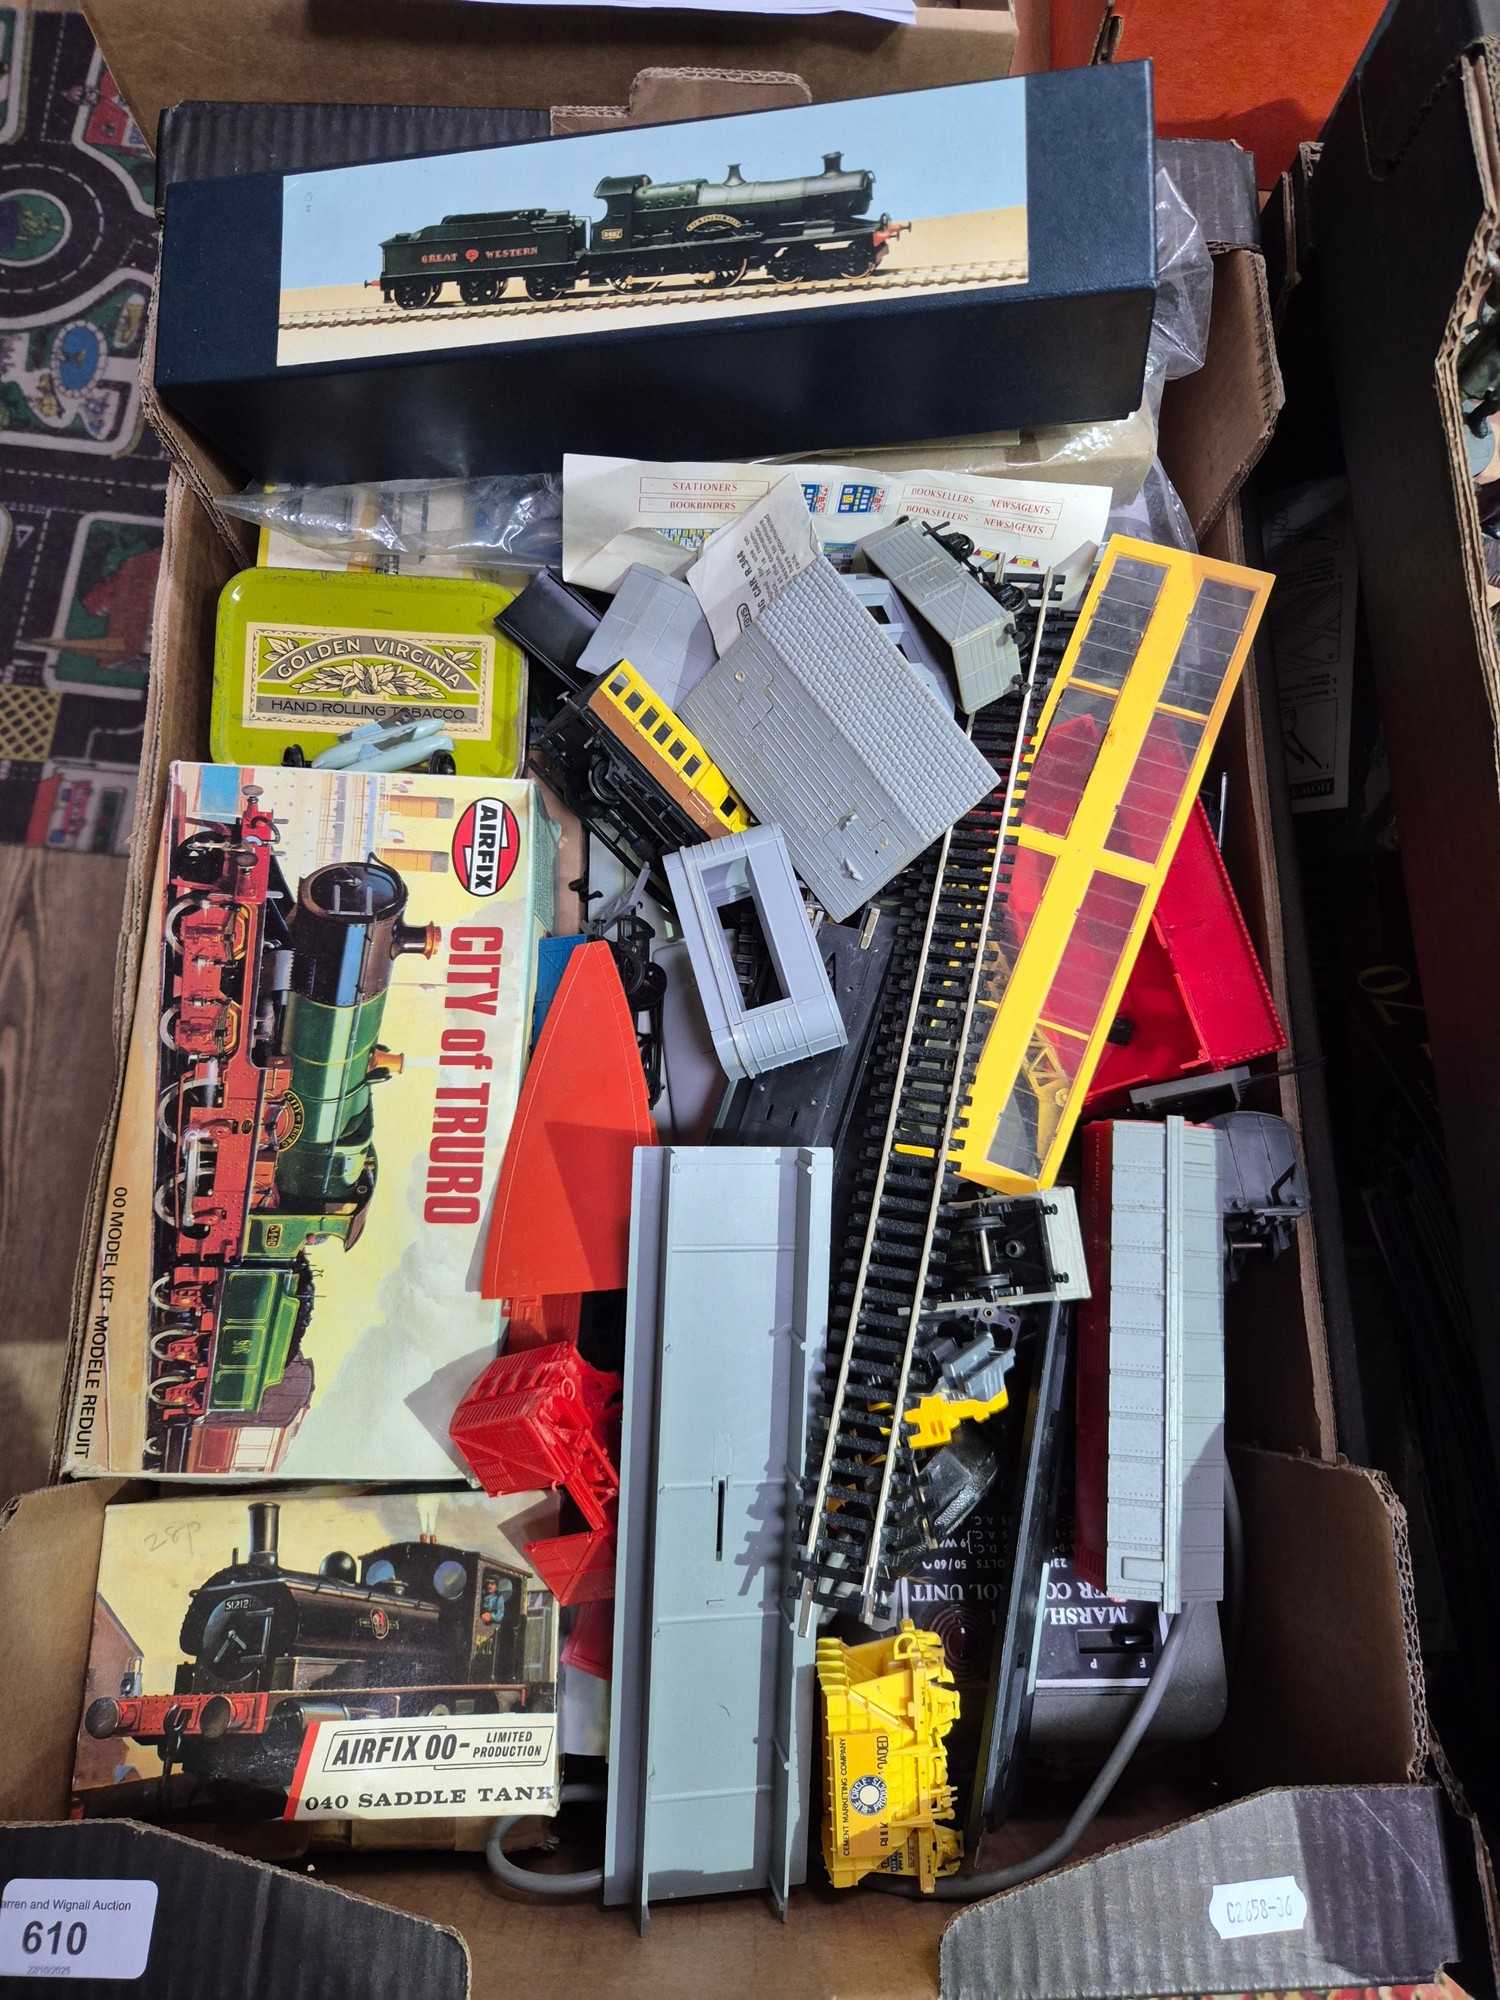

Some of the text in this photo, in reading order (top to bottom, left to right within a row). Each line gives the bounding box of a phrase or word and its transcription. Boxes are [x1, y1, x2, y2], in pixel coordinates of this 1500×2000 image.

[421, 246, 538, 264] GREAT WESTERN
[672, 481, 738, 492] STATIONERS
[669, 501, 736, 510] BOOKBINDERS
[911, 487, 1051, 515] BOOKSELLERS NEWSAGENTS
[906, 504, 1044, 535] BOOKSELLERS NEWSAGENTS
[737, 550, 752, 577] R.344
[749, 577, 761, 598] CAR
[277, 637, 460, 690] GOLDEN VIRGINIA
[271, 699, 465, 720] HAND ROLLING TBACCO
[474, 804, 499, 890] AIRFIX
[423, 926, 504, 1225] CITY of TRURO
[102, 1211, 123, 1272] MODEL
[99, 1275, 115, 1304] KIT
[84, 1314, 110, 1389] MODELE
[74, 1394, 97, 1460] REDUIT
[910, 1583, 966, 1602] UNIT
[1138, 1656, 1147, 1669] F
[332, 1735, 422, 1766] AIRFIX
[472, 1745, 542, 1758] PRODUCTION
[486, 1731, 533, 1744] LIMITED
[839, 1738, 848, 1775] COMPANY
[305, 1786, 555, 1811] 040 SADDLE TANK
[841, 1777, 849, 1824] MARKETING
[851, 1777, 868, 1799] CIRCLE
[872, 1777, 887, 1812] PRODUCTS
[30, 1899, 50, 1910] and
[52, 1899, 91, 1912] Wignall
[92, 1899, 131, 1911] Auction
[22, 1920, 88, 1956] 610
